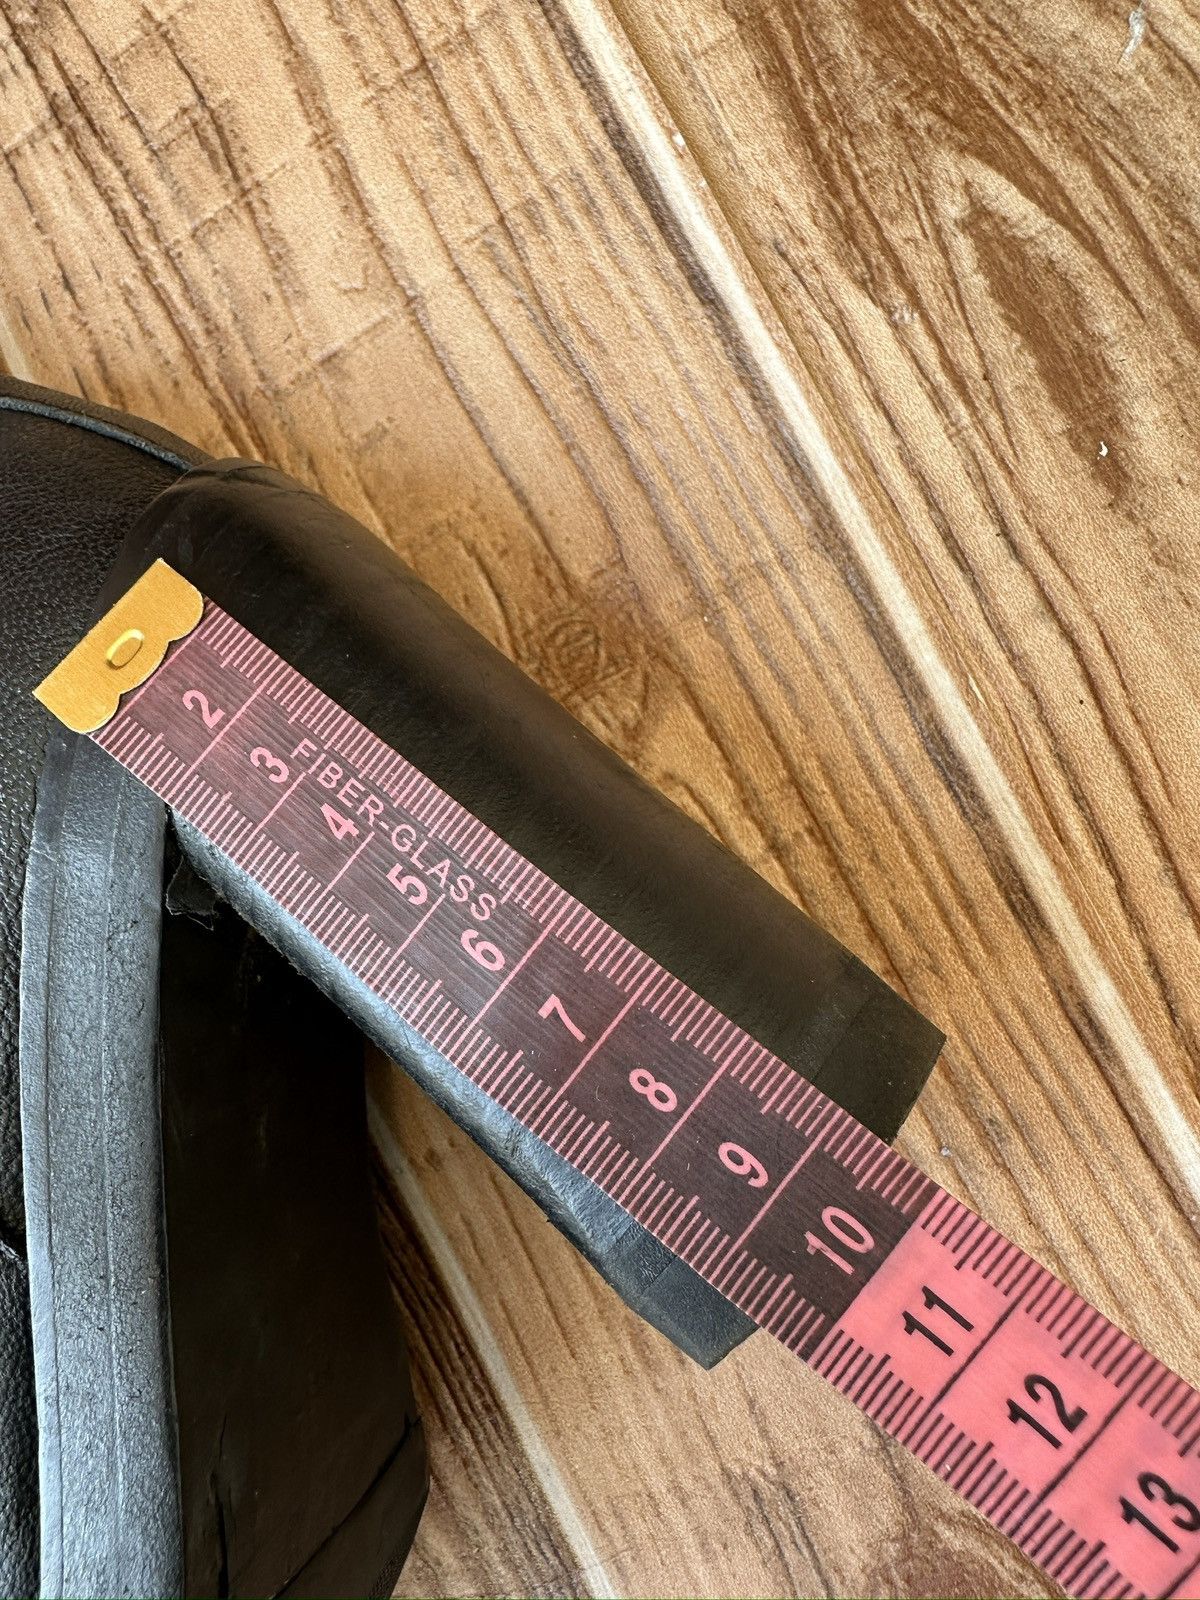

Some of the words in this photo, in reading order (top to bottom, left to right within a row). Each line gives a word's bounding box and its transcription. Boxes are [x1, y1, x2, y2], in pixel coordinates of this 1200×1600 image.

[182, 689, 226, 730] 2
[249, 746, 291, 784] 3
[290, 739, 497, 921] FIBER-GLASS
[321, 802, 360, 841] 4
[386, 864, 428, 905] 5
[460, 929, 506, 972] 6
[537, 993, 586, 1043] 7
[628, 1068, 678, 1113] 8
[717, 1141, 769, 1188] 9
[804, 1205, 875, 1275] 10
[902, 1285, 974, 1357] 11
[1006, 1373, 1088, 1450] 12
[1118, 1471, 1200, 1554] 13
